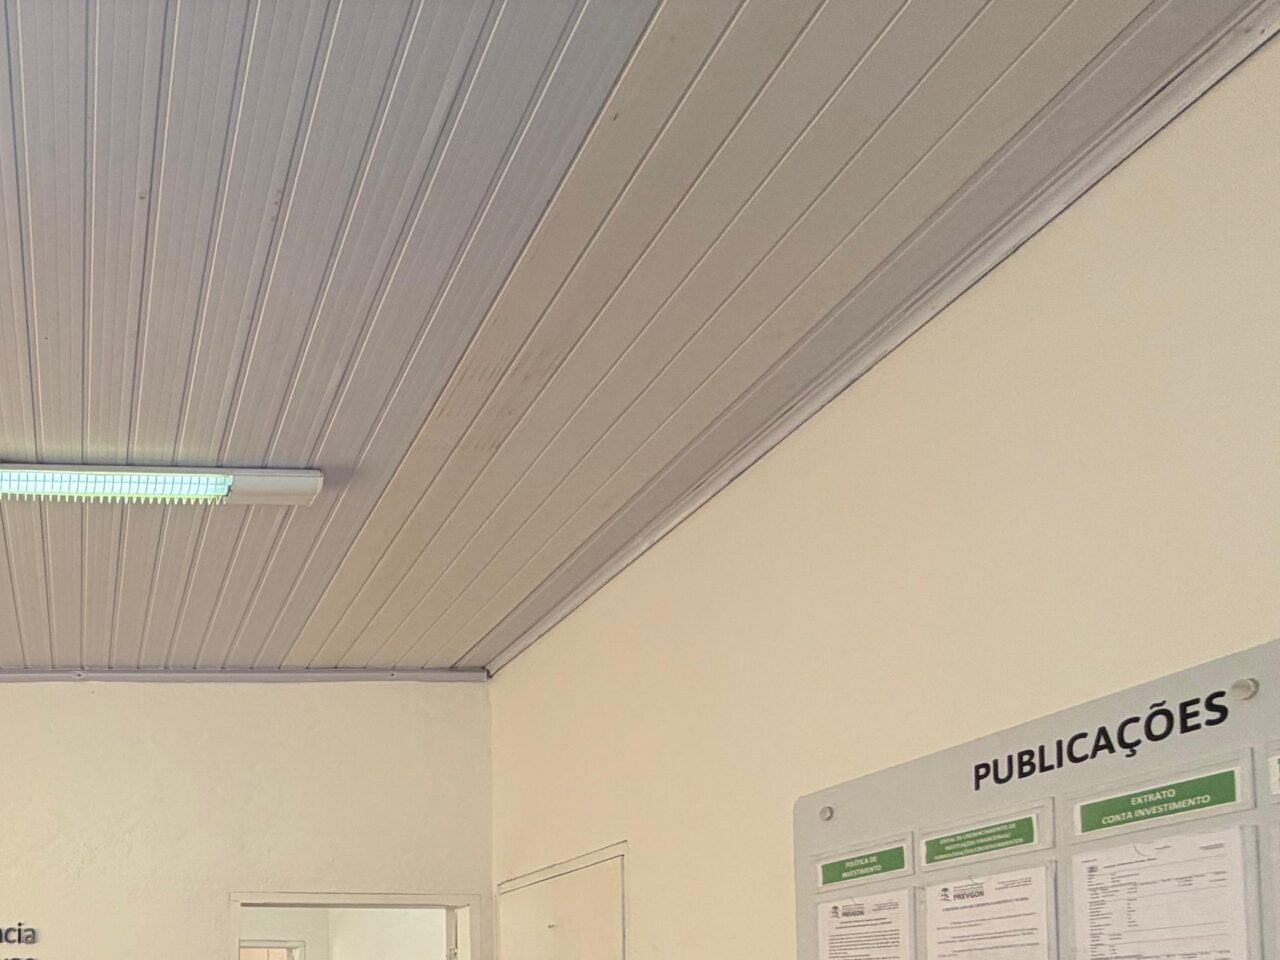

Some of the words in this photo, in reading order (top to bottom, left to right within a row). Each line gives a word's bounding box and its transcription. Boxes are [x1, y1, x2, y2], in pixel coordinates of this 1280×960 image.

[973, 690, 1230, 791] PUBLICAÇÕES
[1130, 788, 1176, 806] EXTRATO
[1101, 812, 1133, 825] CONTA
[1134, 794, 1211, 818] INVESTIMENTO
[845, 857, 869, 869] POLÍTICA
[869, 855, 878, 863] DE
[841, 864, 882, 879] INVESTIMENTO
[953, 890, 985, 901] PREVGON
